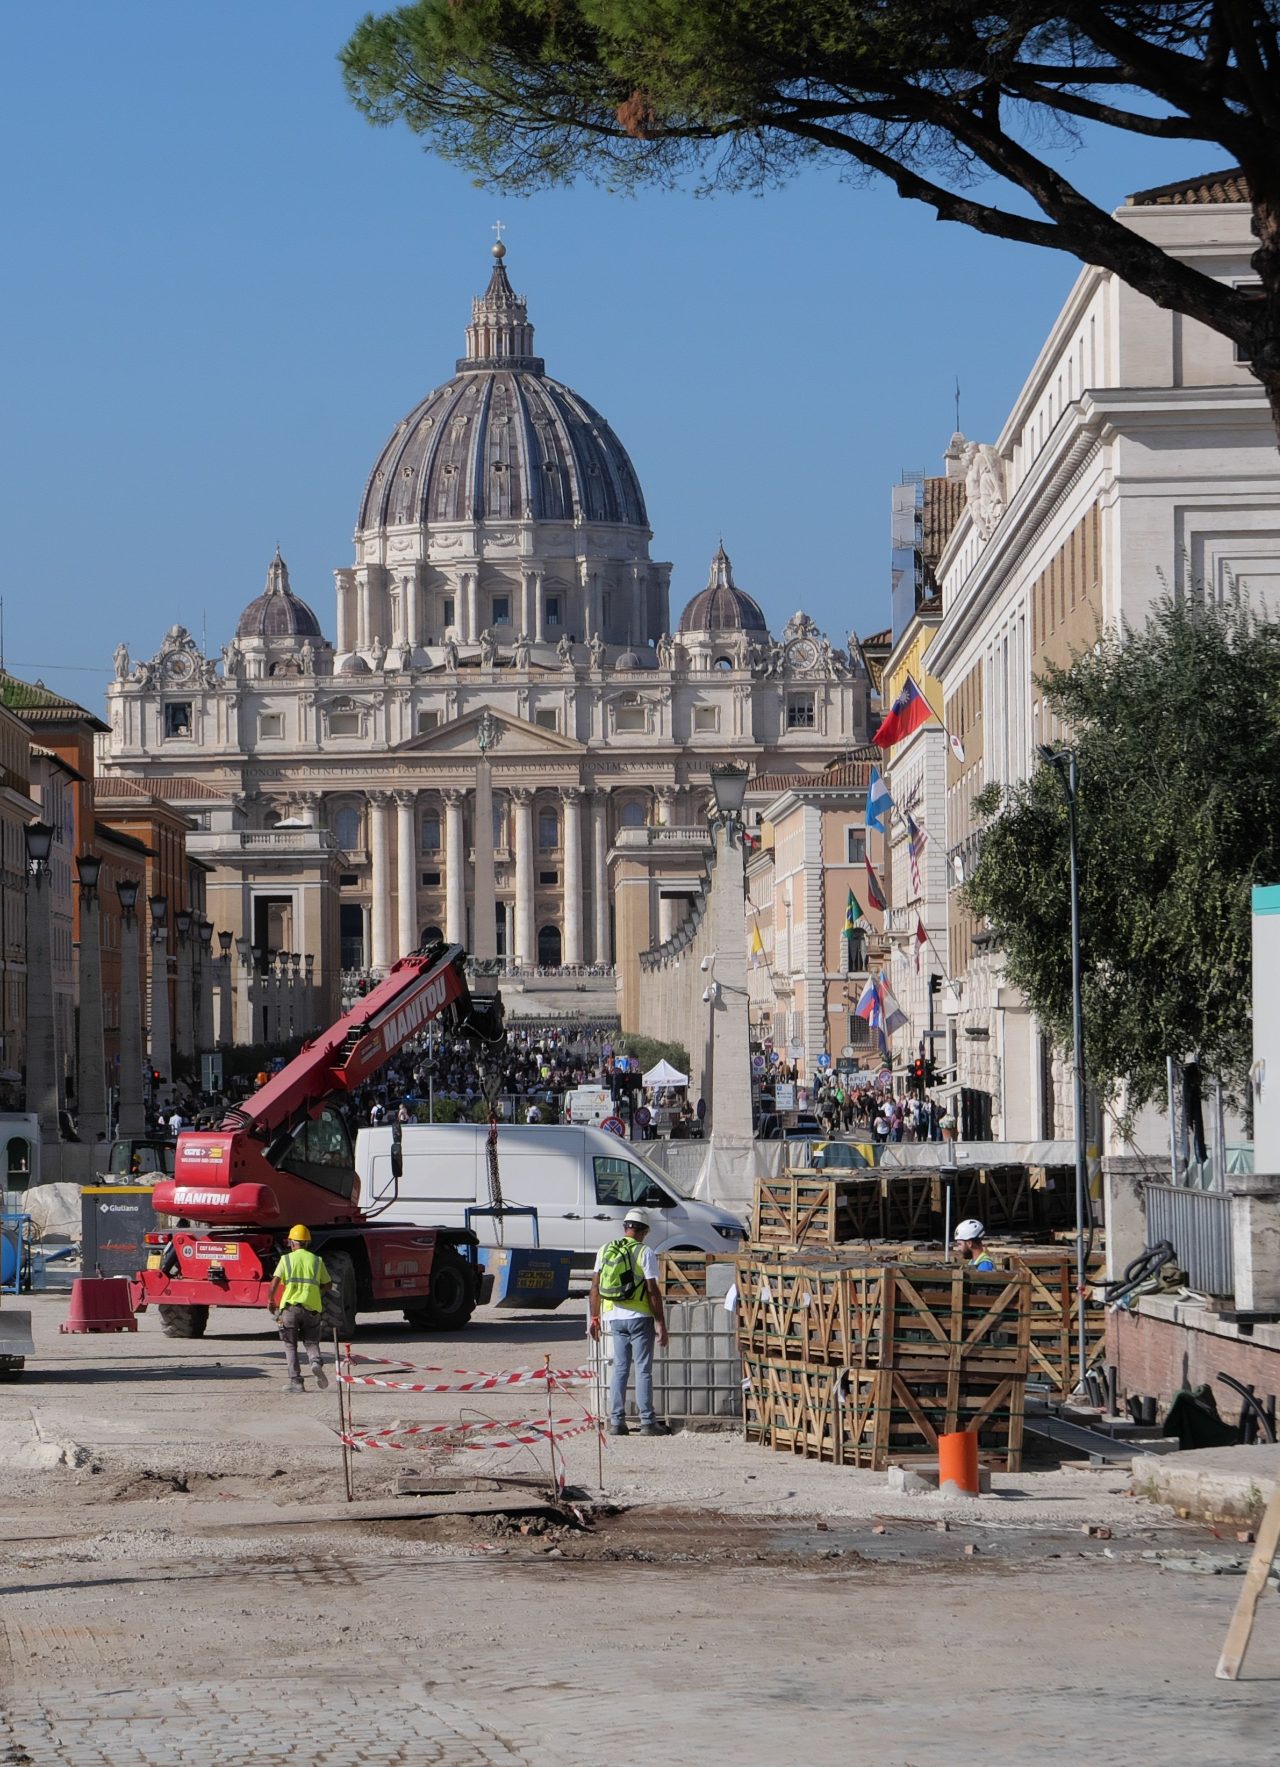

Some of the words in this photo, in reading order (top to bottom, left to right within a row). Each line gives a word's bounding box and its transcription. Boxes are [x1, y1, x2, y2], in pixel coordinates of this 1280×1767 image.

[223, 768, 237, 777] IN
[383, 976, 447, 1052] MANITOU
[174, 1192, 230, 1205] MANITOU
[109, 1204, 139, 1212] Giuliano
